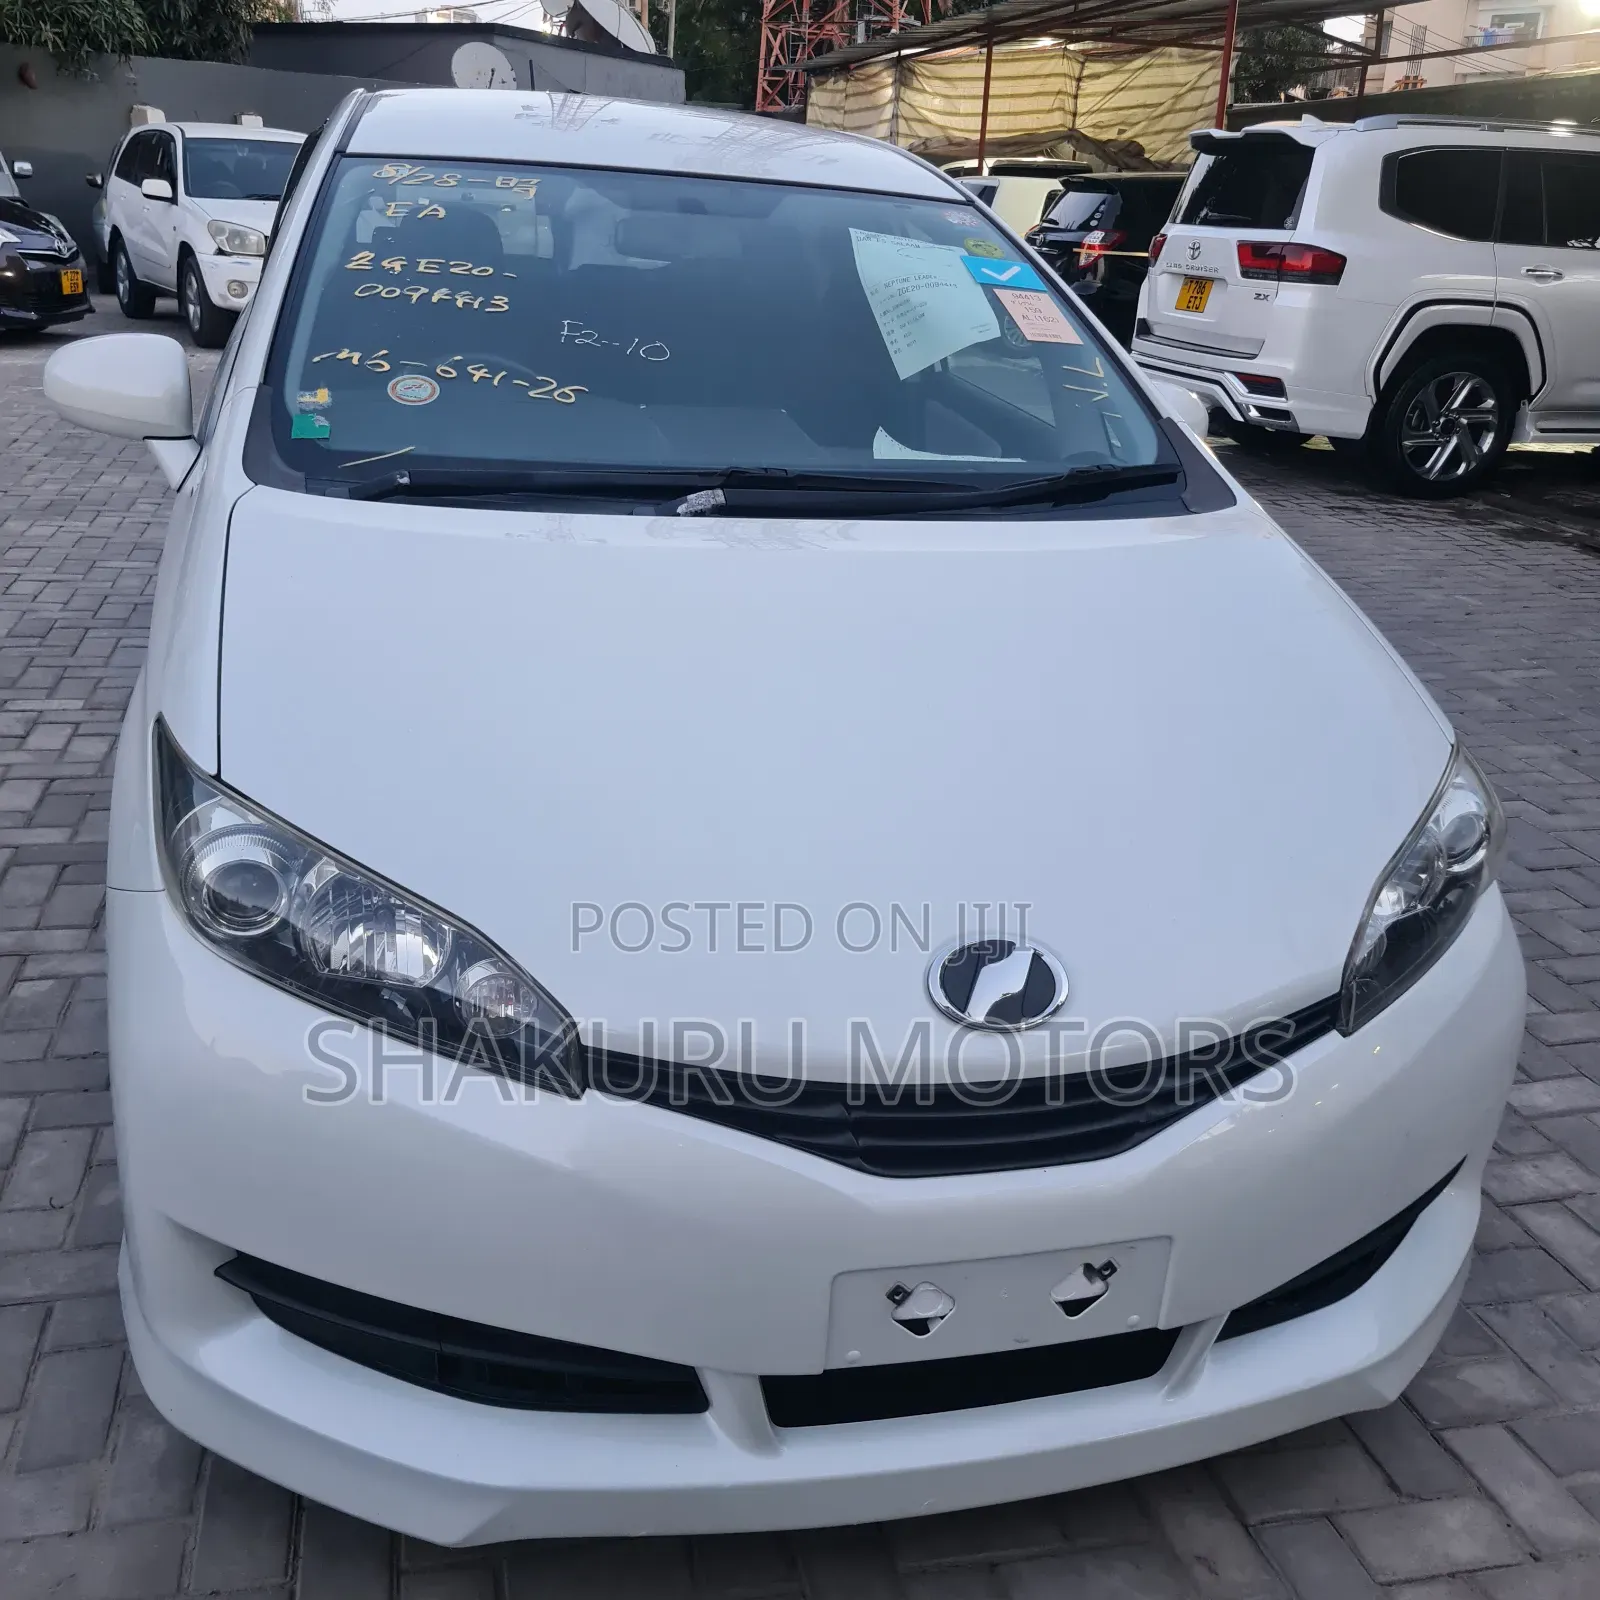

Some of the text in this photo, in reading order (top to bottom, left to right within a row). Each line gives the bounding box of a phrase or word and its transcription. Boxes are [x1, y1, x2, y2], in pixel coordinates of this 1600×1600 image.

[883, 276, 911, 289] NEPTUNE
[1192, 280, 1208, 295] 786
[1186, 295, 1203, 310] ETJ
[1253, 292, 1271, 302] ZX
